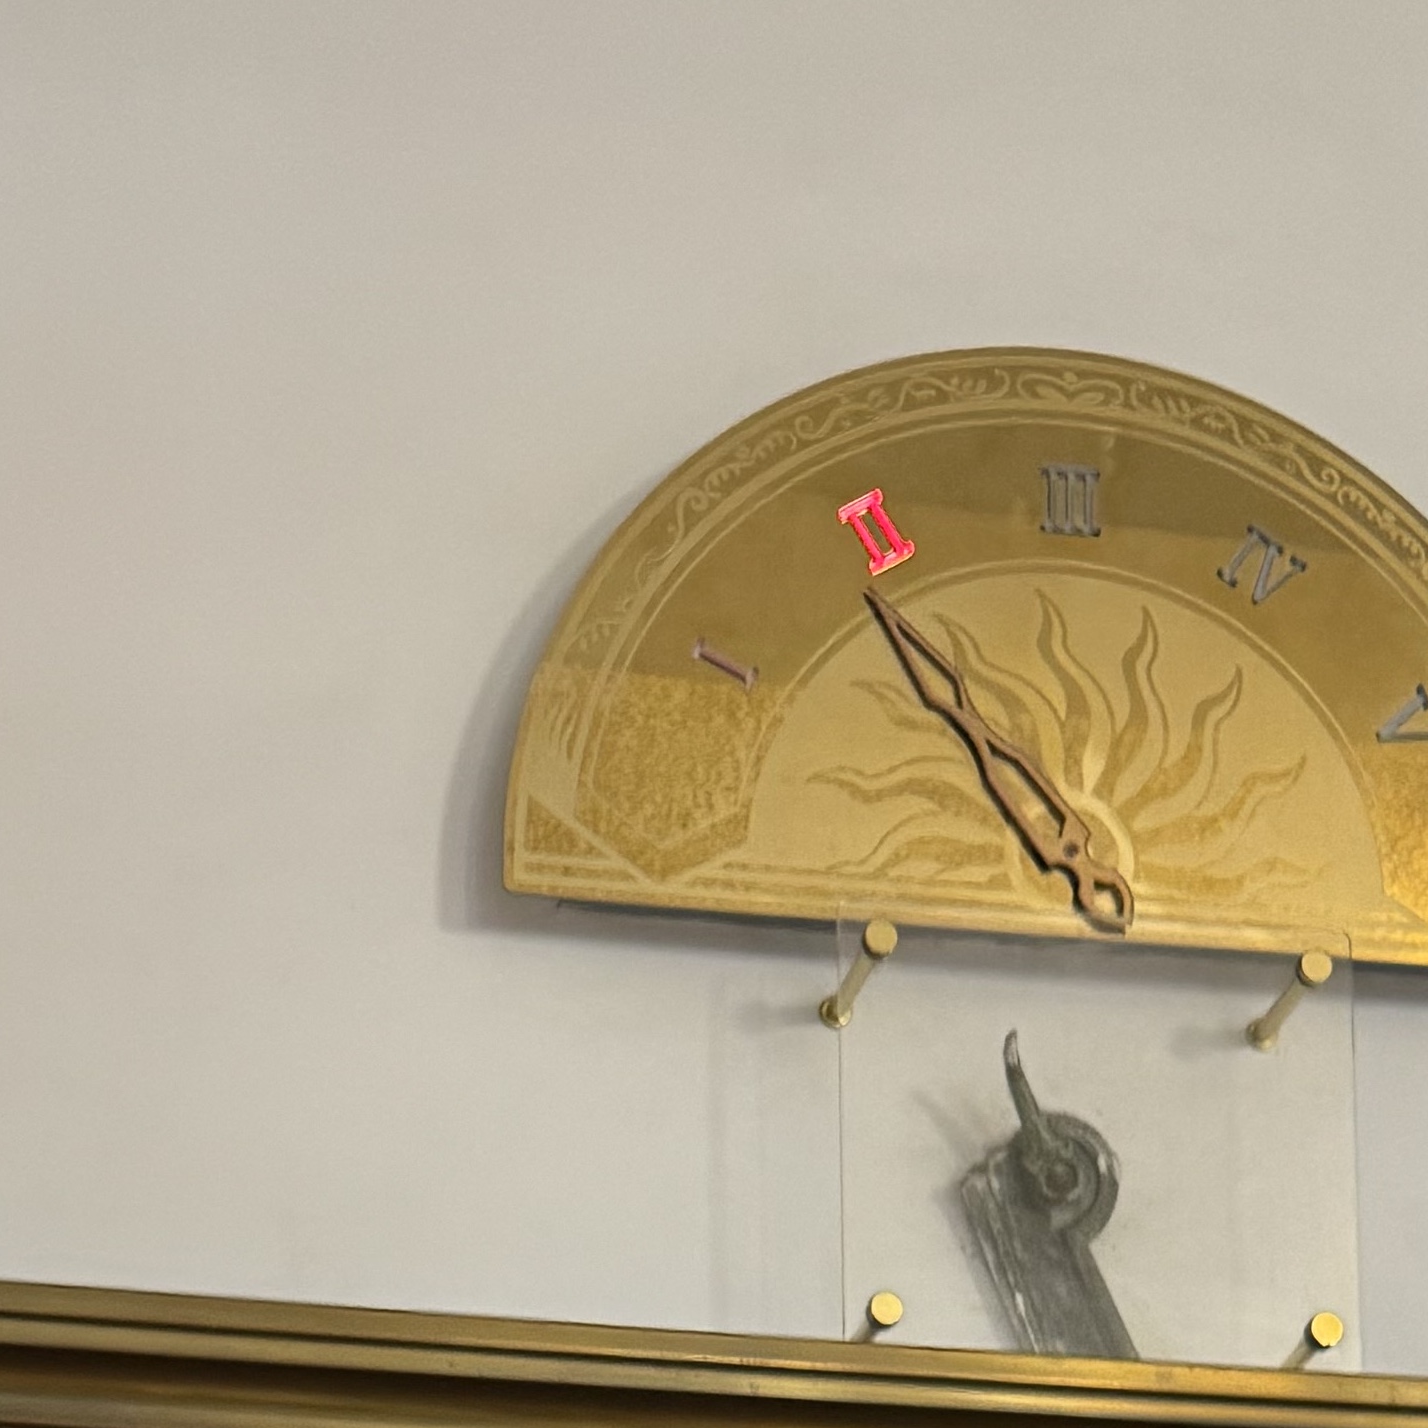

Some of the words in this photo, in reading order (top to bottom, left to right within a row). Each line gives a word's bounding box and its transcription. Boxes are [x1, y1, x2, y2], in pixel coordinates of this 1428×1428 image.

[837, 488, 914, 576] II
[1040, 463, 1101, 537] III
[1216, 524, 1306, 605] IV
